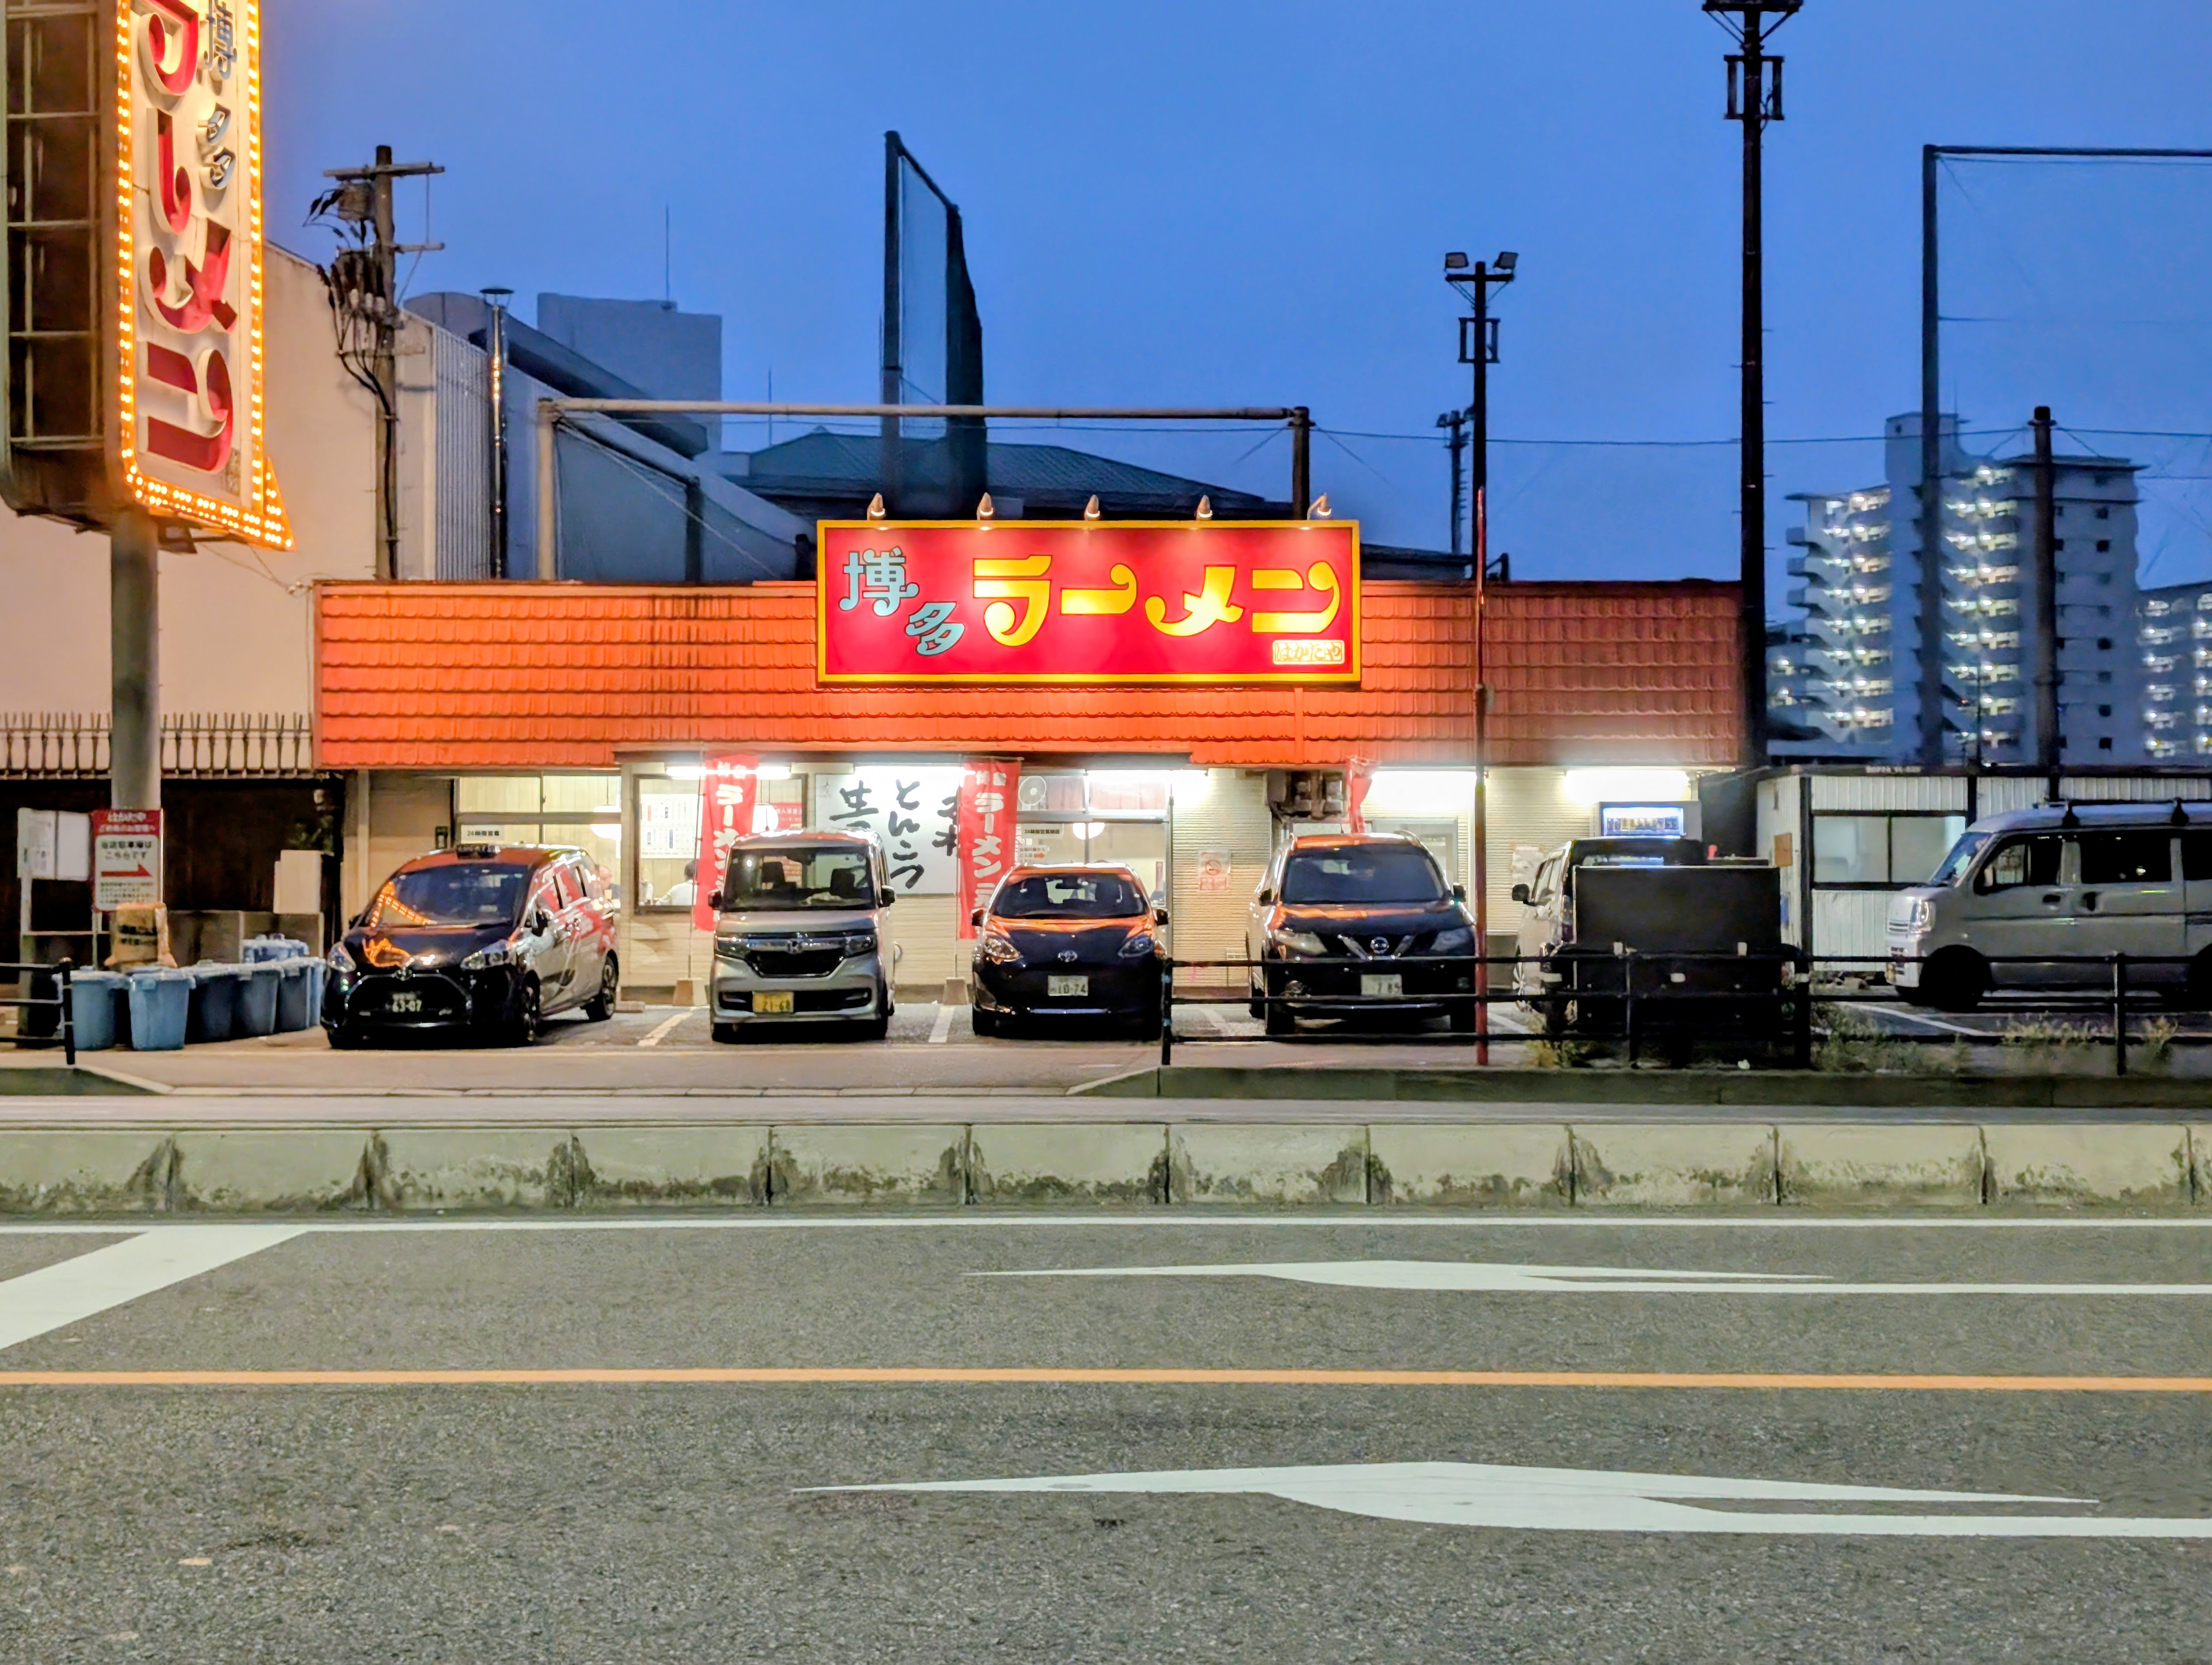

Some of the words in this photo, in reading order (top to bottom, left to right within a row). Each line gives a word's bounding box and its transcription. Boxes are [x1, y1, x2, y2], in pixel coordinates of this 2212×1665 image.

[142, 0, 237, 472] ラーメン
[972, 554, 1341, 647] ラーメン
[829, 780, 879, 829] 生
[888, 779, 925, 889] とんこつ
